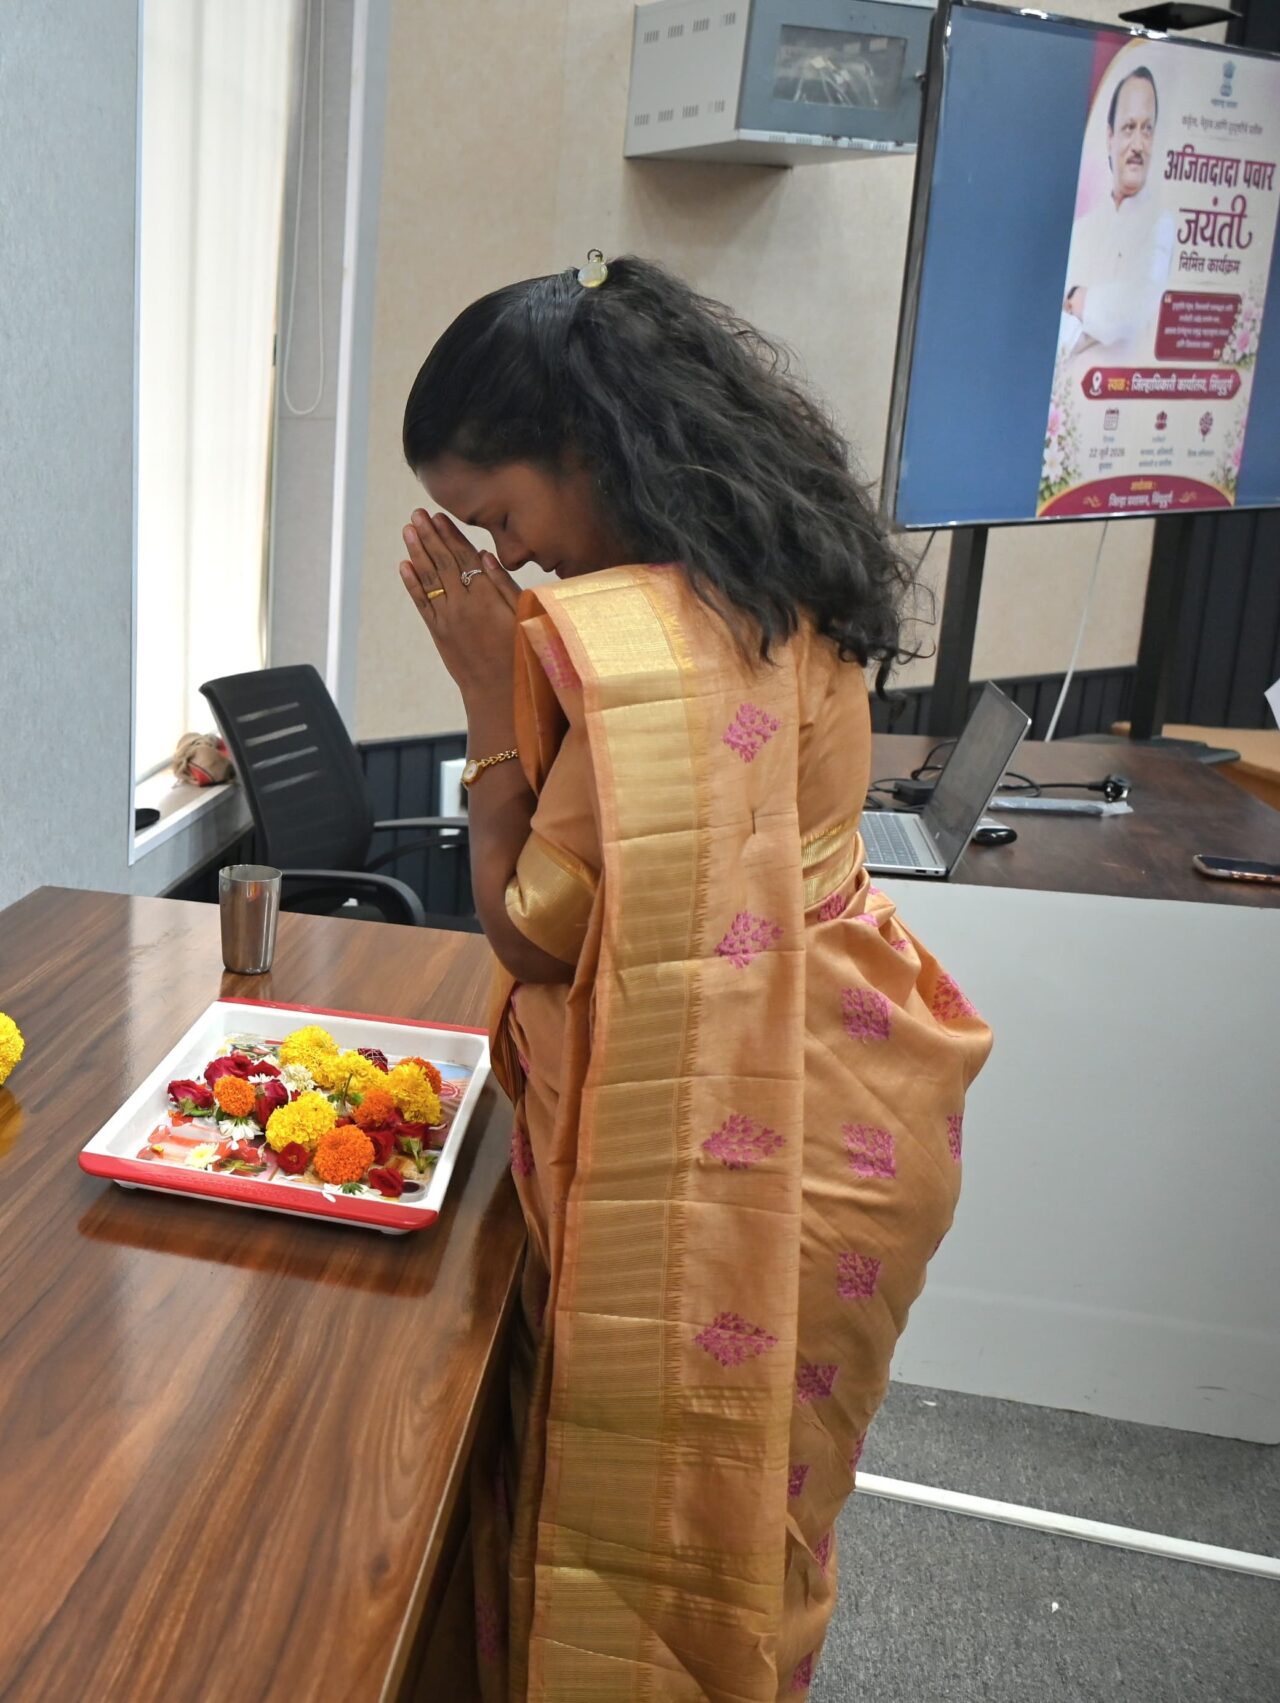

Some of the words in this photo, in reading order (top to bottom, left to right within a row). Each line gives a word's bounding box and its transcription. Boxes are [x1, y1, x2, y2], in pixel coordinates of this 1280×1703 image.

[1164, 144, 1241, 188] अजितदादा
[1243, 160, 1276, 191] पवार
[1177, 195, 1252, 249] जयंती
[1179, 251, 1206, 272] निमित्त
[1207, 254, 1241, 275] कार्यक्रम
